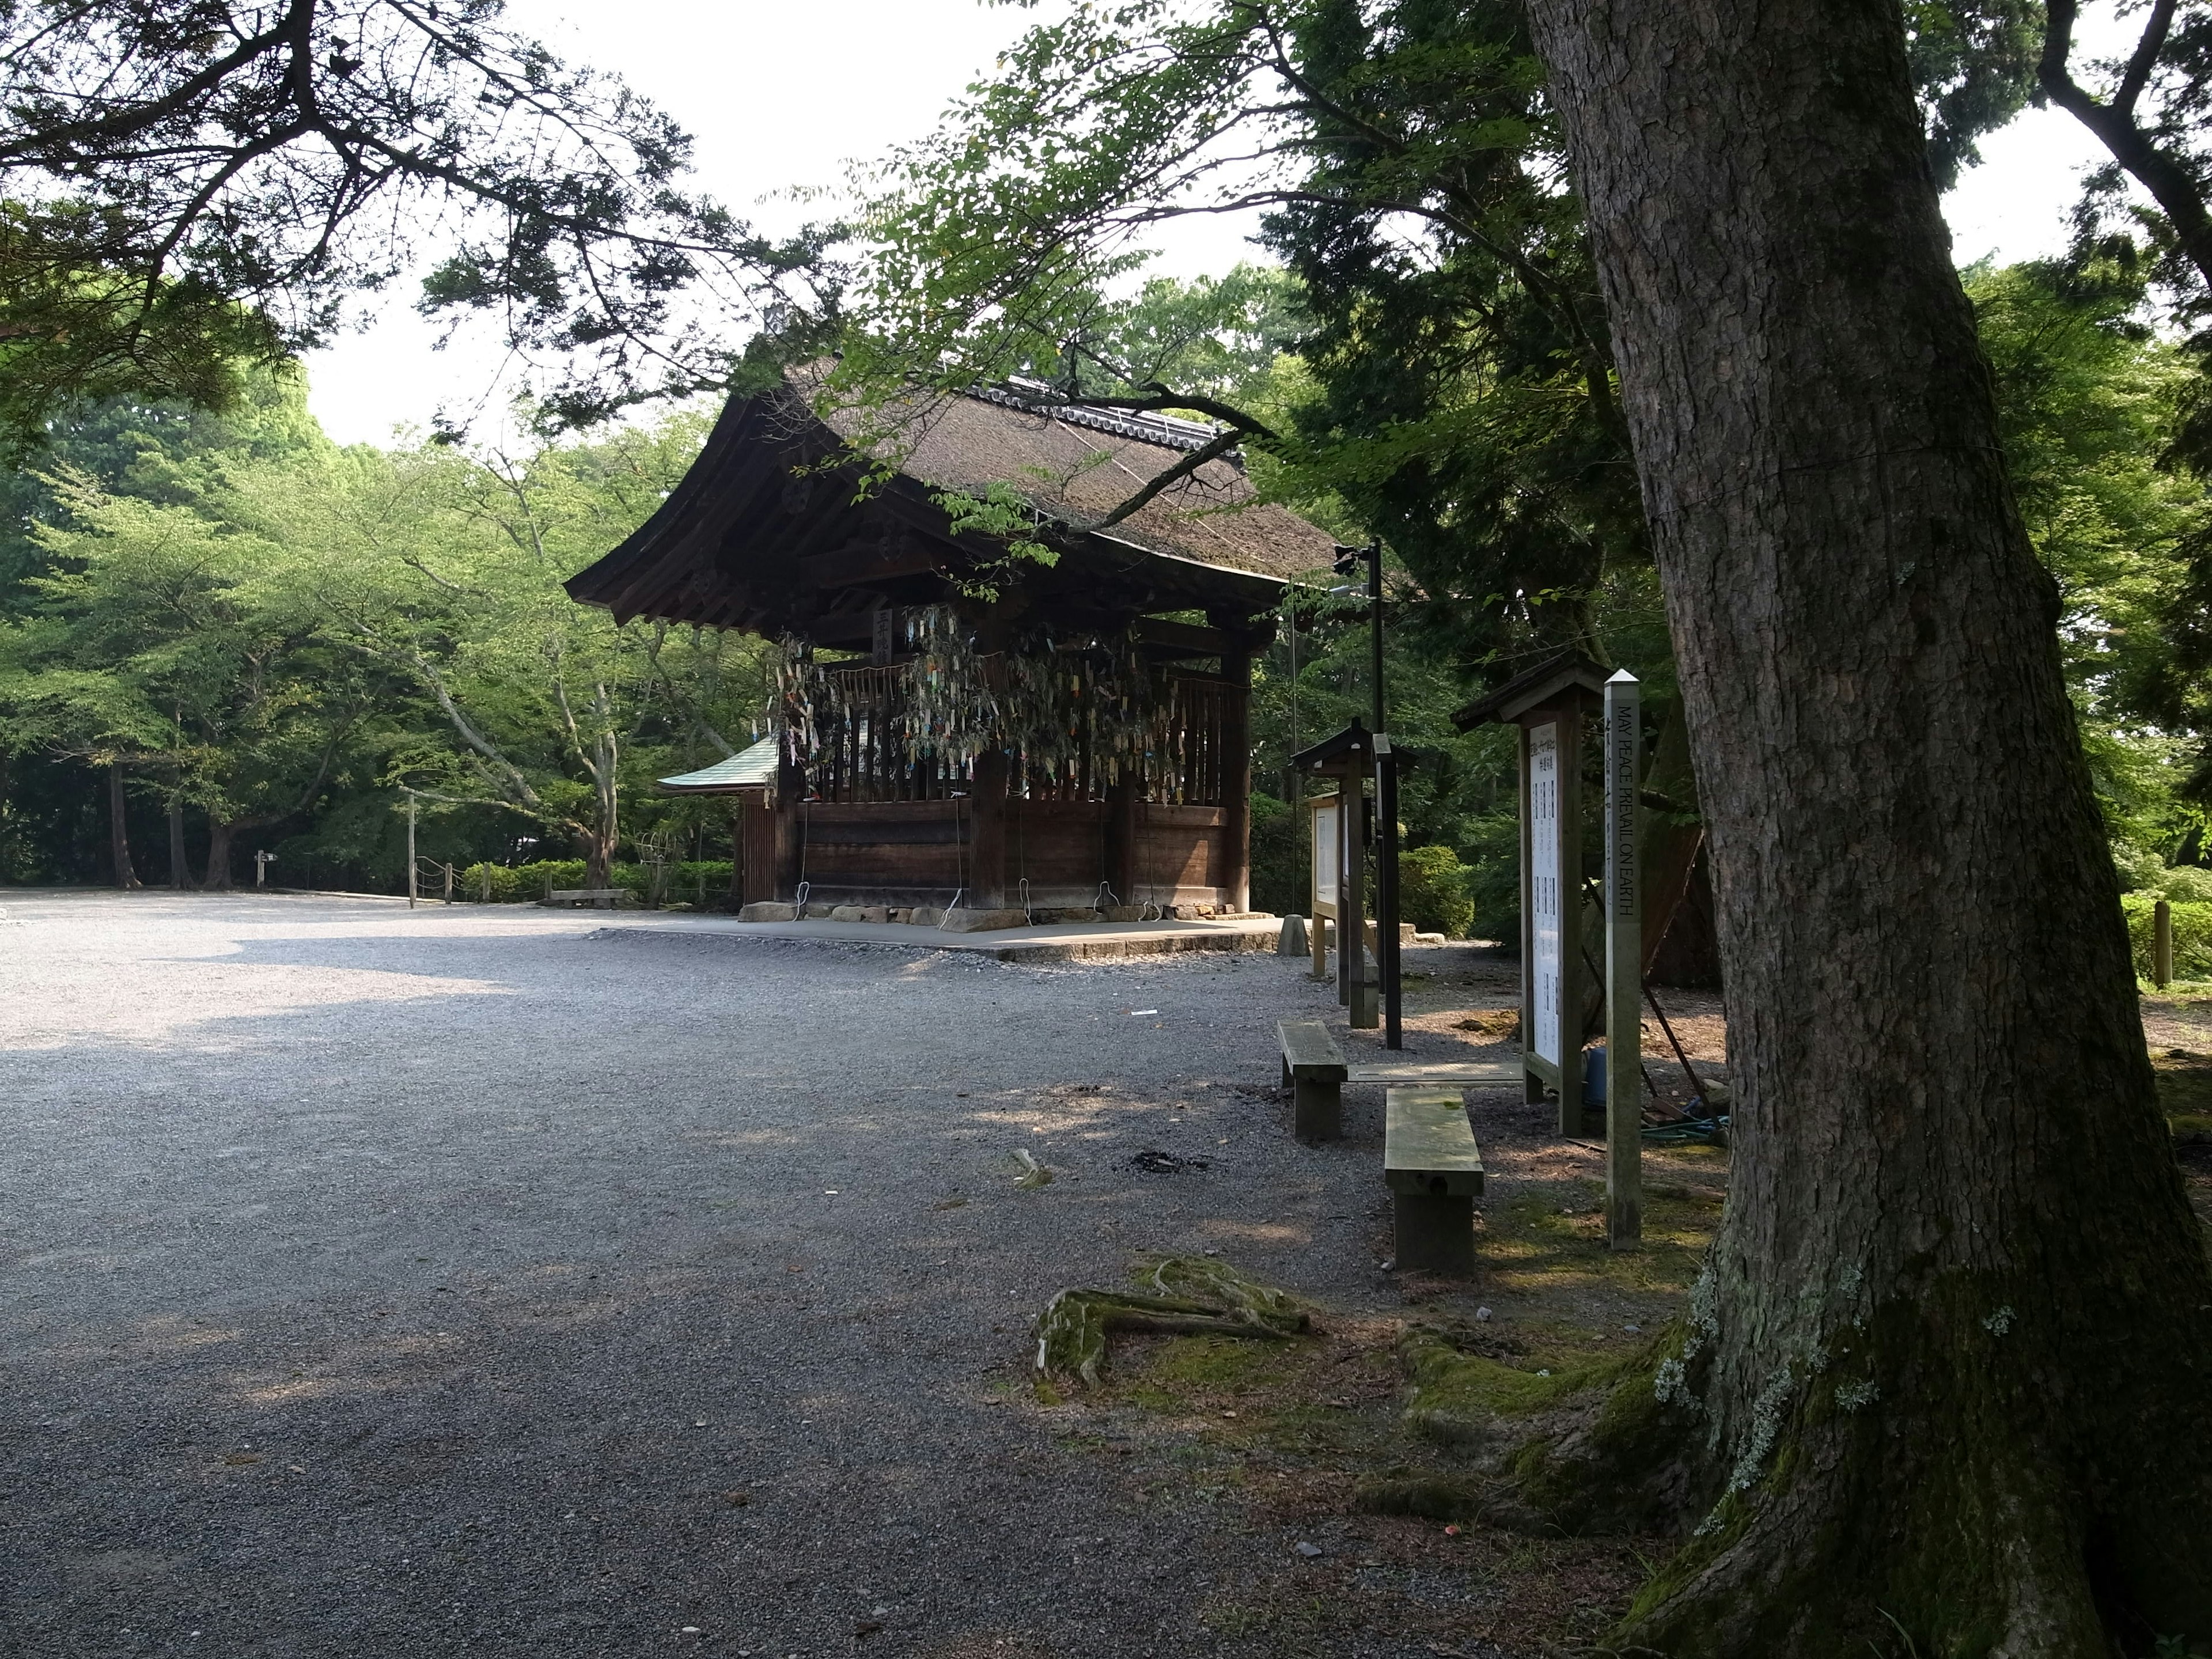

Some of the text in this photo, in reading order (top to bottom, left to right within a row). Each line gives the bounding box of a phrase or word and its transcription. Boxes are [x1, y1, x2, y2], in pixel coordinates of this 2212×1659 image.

[1618, 706, 1634, 916] MAY PEACE PREVAIL ON EARTH
